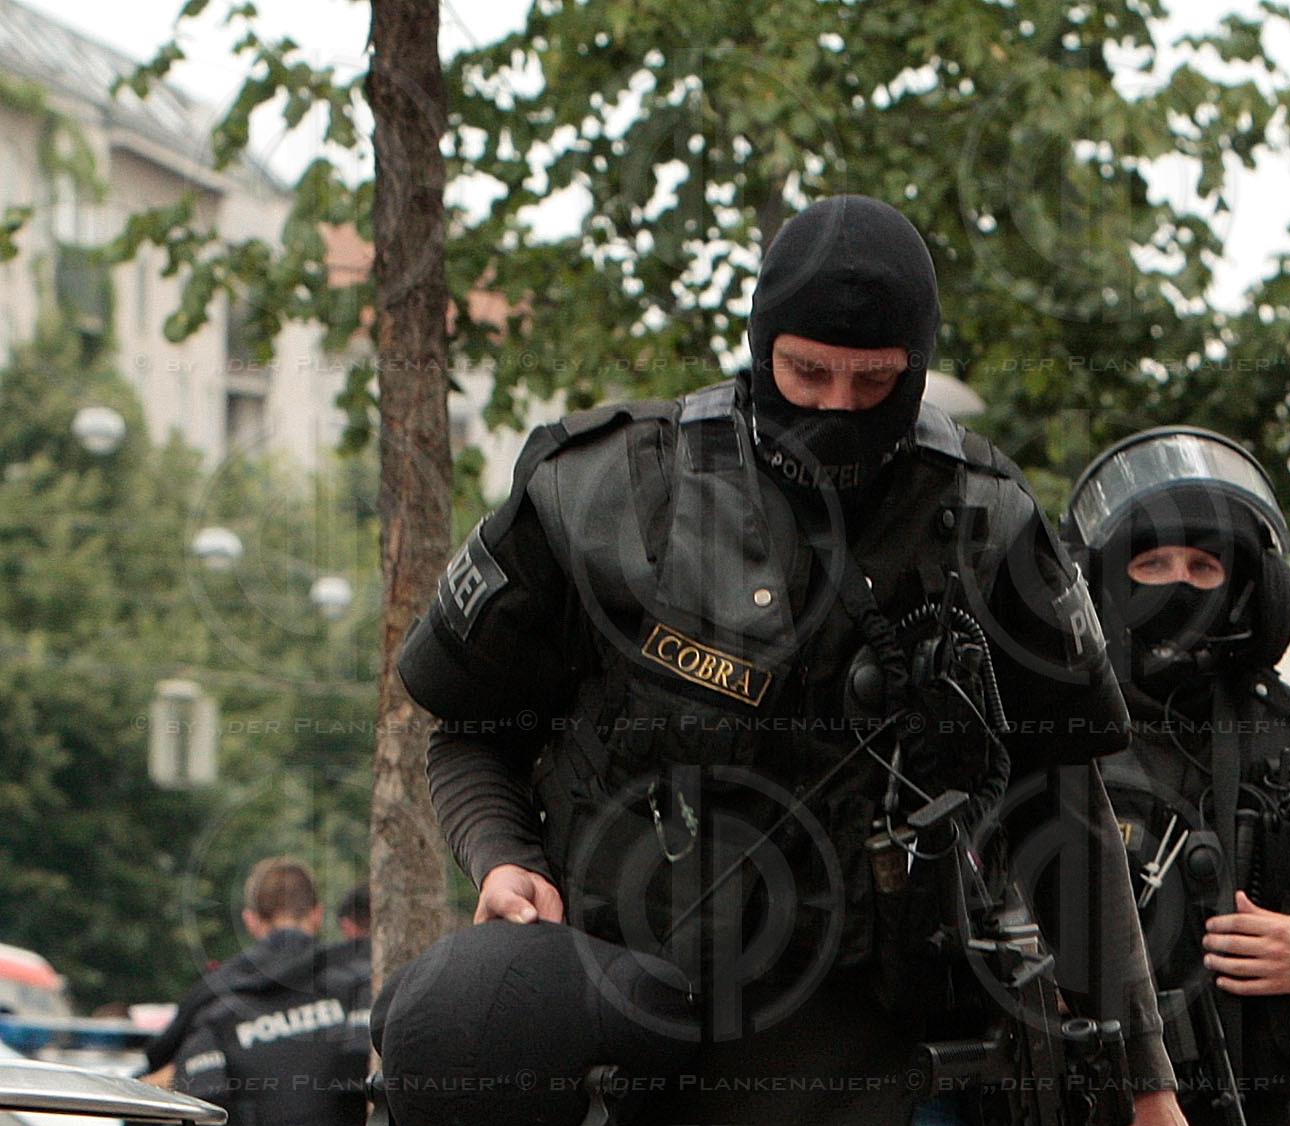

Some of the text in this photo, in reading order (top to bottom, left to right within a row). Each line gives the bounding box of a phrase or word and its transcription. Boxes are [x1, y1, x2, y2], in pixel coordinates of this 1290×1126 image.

[771, 451, 860, 489] POLIZEI
[656, 634, 755, 697] COBRA
[235, 998, 348, 1049] POLIZEI
